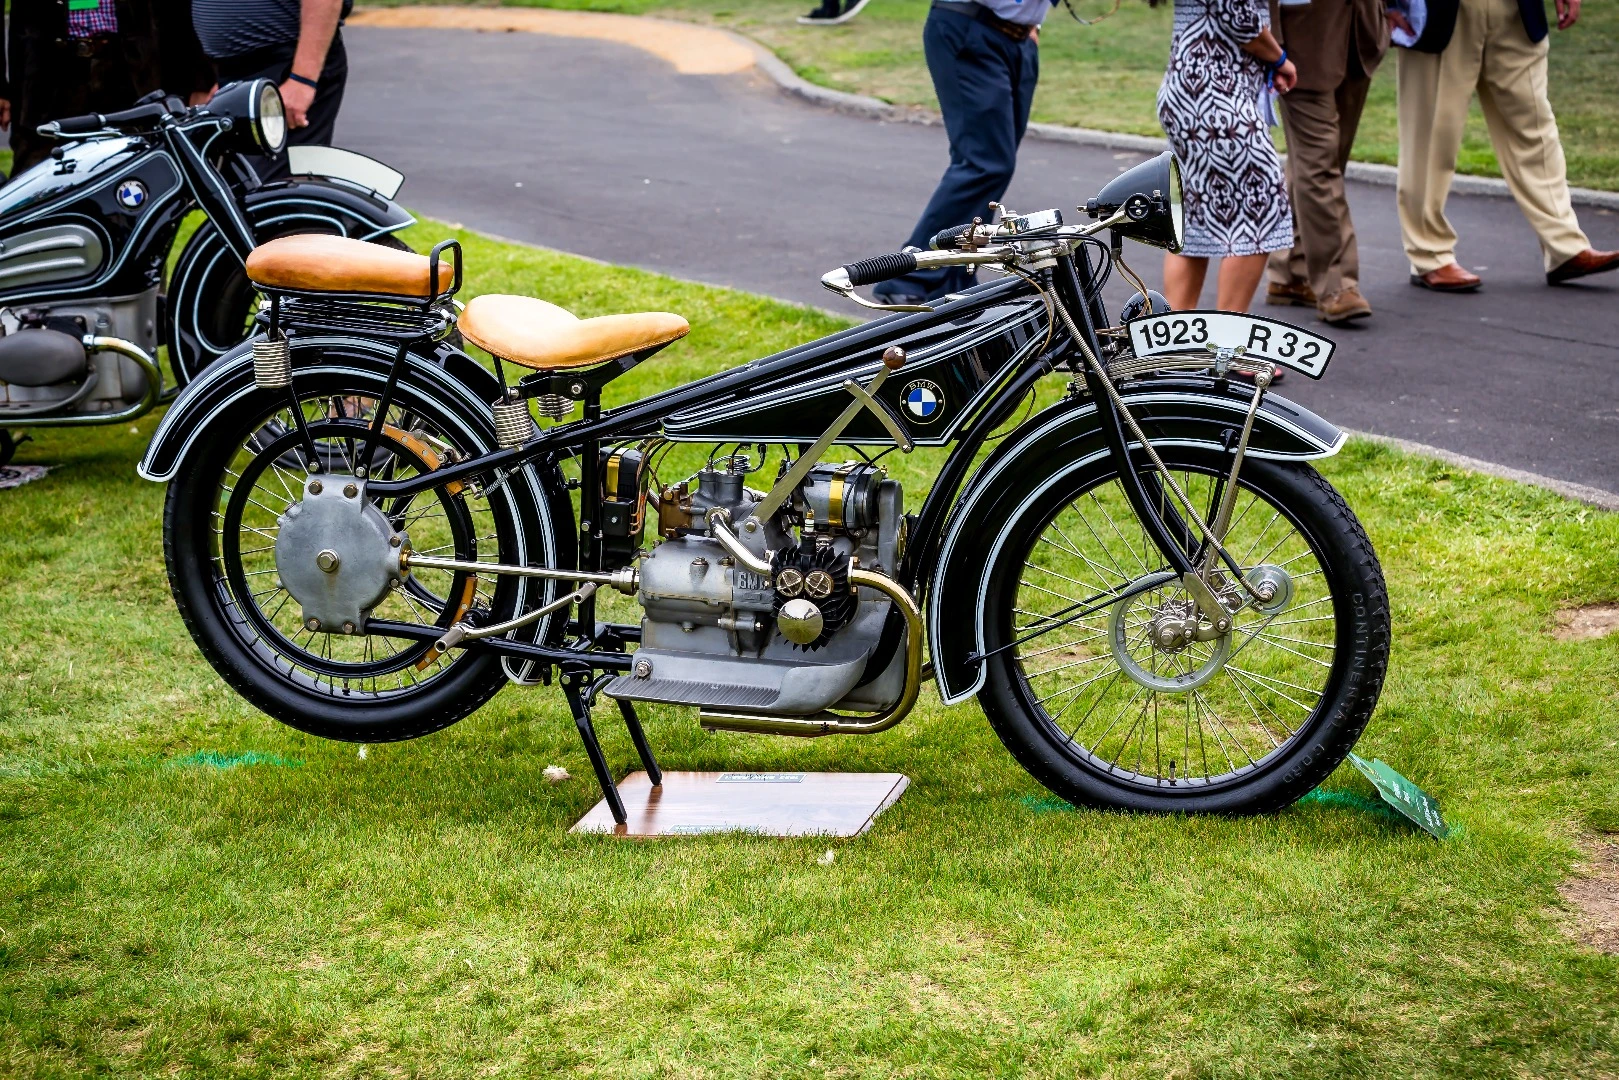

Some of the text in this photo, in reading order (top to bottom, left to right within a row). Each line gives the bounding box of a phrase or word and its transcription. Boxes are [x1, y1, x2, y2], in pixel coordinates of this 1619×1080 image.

[1139, 317, 1321, 369] 1923 R 32
[909, 381, 936, 390] BMW
